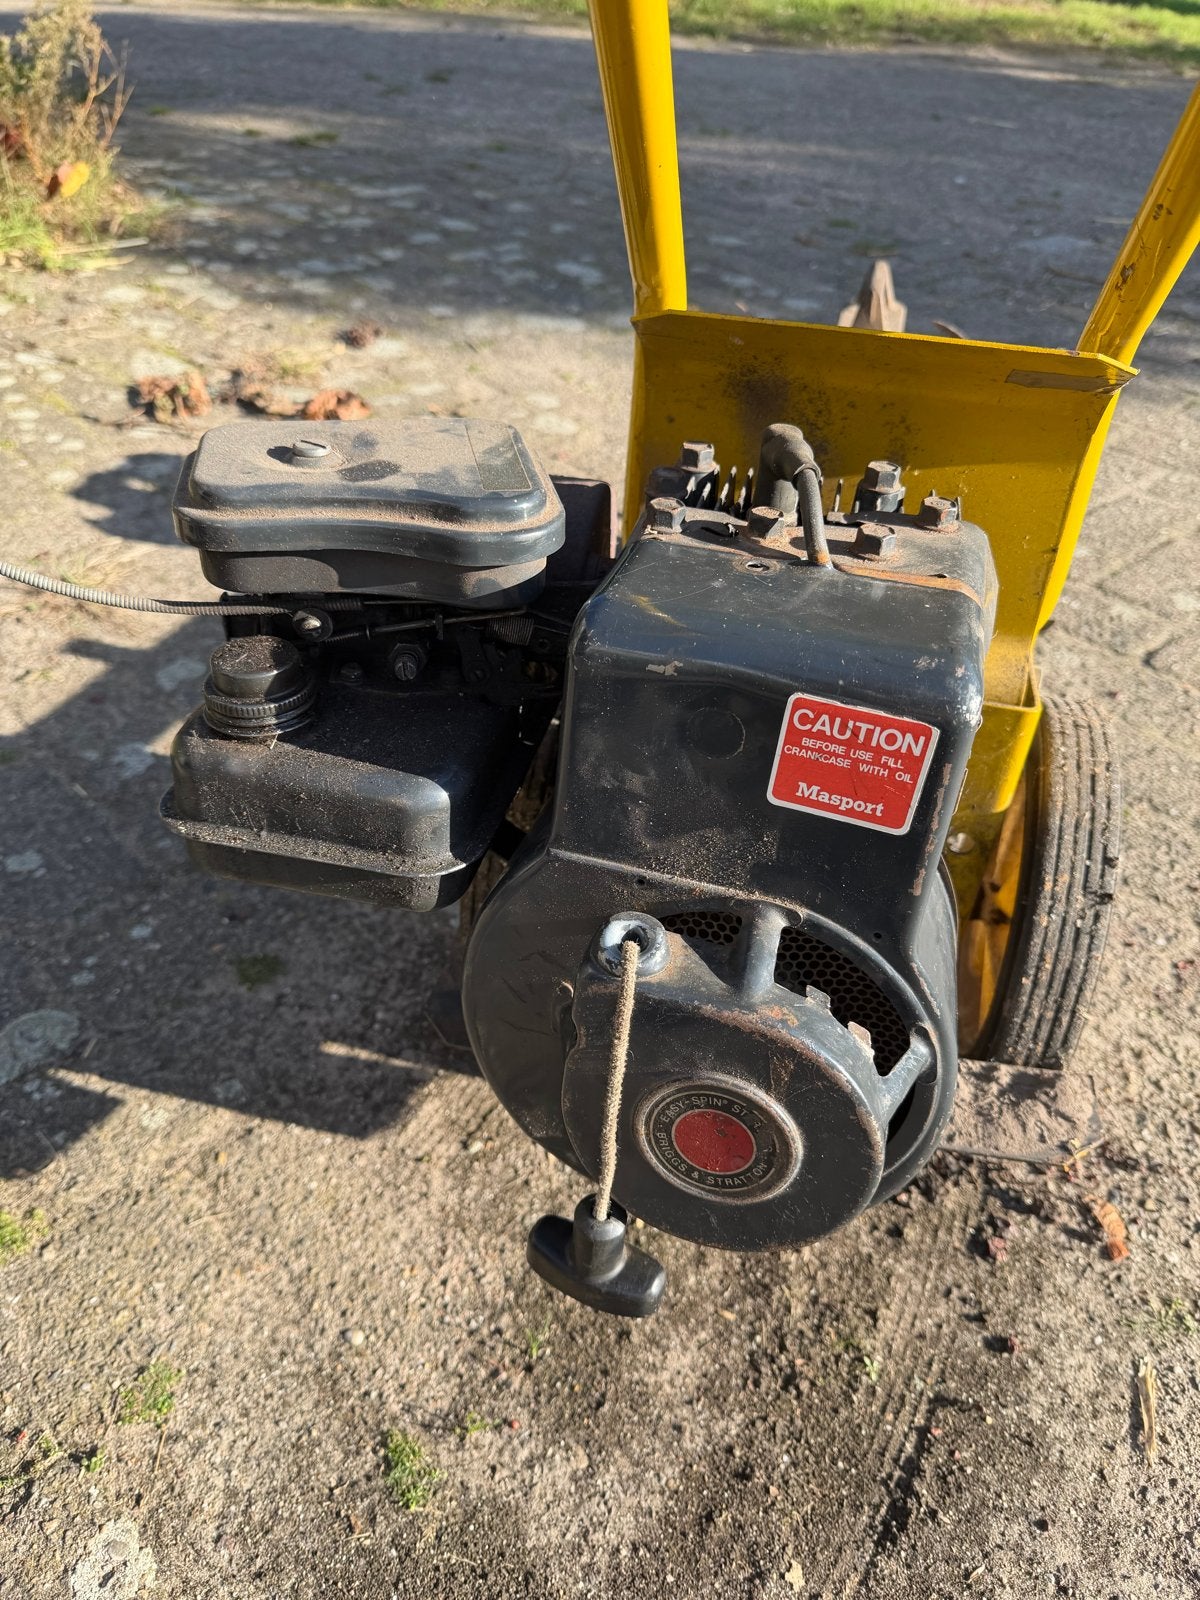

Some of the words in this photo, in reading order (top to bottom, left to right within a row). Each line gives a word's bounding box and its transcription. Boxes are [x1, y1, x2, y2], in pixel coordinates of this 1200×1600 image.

[793, 709, 926, 757] CAUTION
[784, 745, 852, 769] CRANKCASE
[859, 763, 889, 778] WITH
[895, 771, 913, 784] OIL
[801, 737, 847, 755] BEFORE
[850, 748, 874, 762] USE
[881, 755, 904, 769] FILL
[795, 781, 884, 817] Masport
[657, 1132, 688, 1175] BRIGGS
[691, 1171, 700, 1180] &
[707, 1161, 767, 1187] STRATTON
